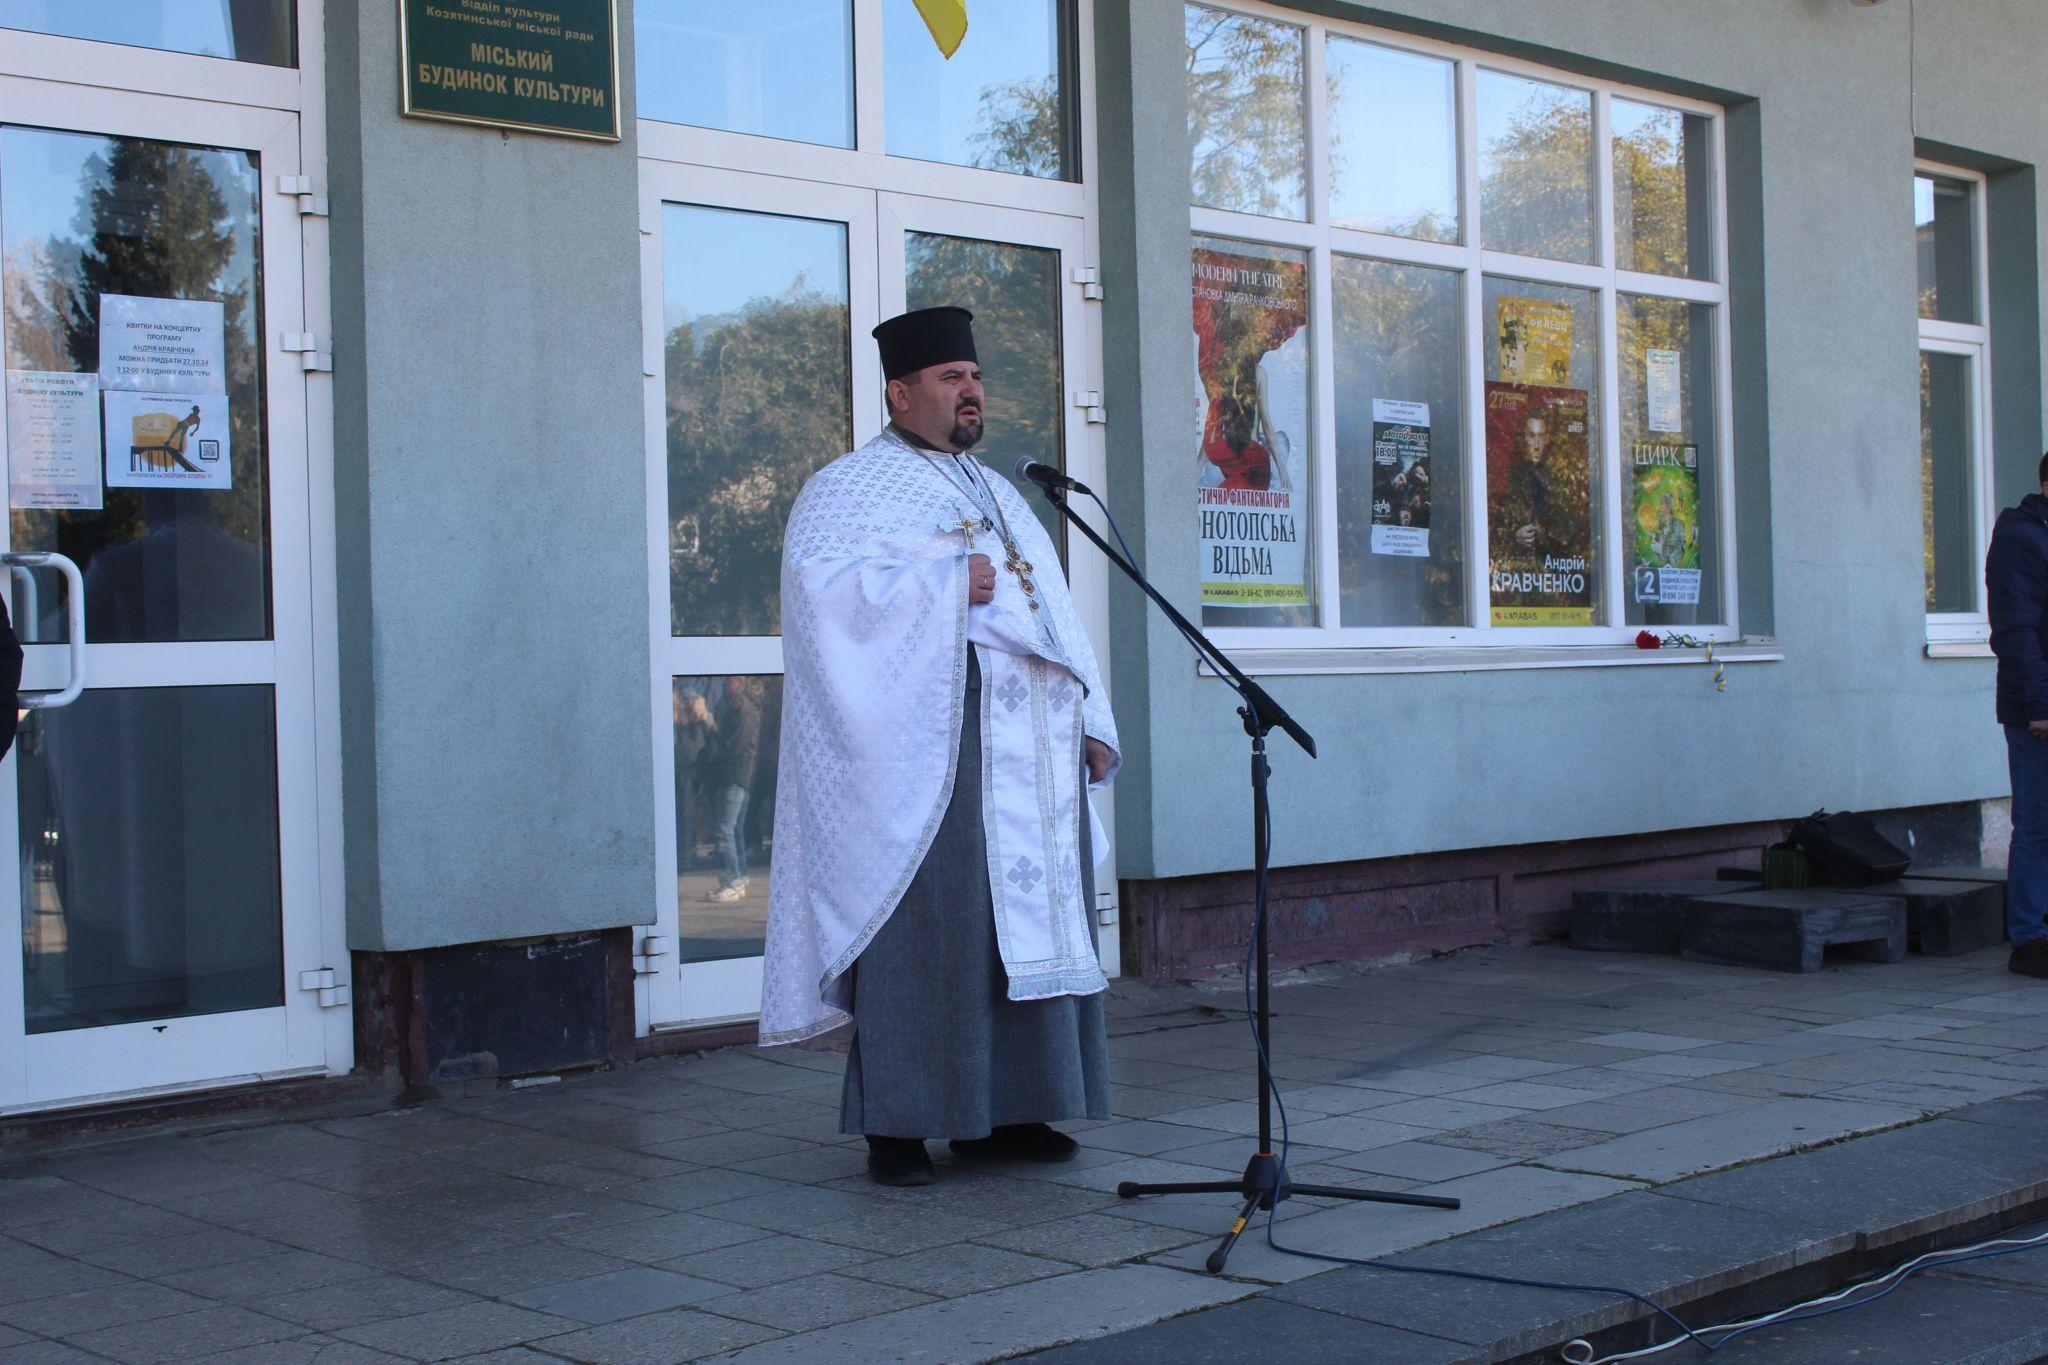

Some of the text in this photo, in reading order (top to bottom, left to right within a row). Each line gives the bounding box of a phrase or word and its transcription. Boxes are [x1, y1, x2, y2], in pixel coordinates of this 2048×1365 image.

[461, 0, 560, 23] Відділ культури
[426, 6, 594, 42] Козятинської міської ради
[471, 42, 553, 72] МІСЬКИЙ
[419, 63, 605, 108] БУДИНОК КУЛЬТУРИ
[1192, 262, 1286, 289] MODERN THEATRE
[126, 322, 153, 330] КВИТКИ
[164, 325, 202, 334] КОНЦЕРТНУ
[147, 334, 182, 342] ПРОГРАМУ
[119, 355, 145, 363] МОЖНА
[133, 344, 195, 354] АНДРІЯ КРАВЧЕНКА
[146, 368, 177, 376] БУДИНКУ
[177, 369, 211, 377] КУЛЬТУРИ
[1489, 390, 1504, 409] 27
[1634, 444, 1682, 467] ЦИРК
[1229, 489, 1290, 508] ФАНТАСМАГОРІЯ
[1198, 510, 1296, 542] НОТОПСЬКА
[1212, 545, 1273, 580] ВІДЬМА
[1544, 554, 1585, 573] Андрій
[1491, 572, 1585, 593] КРАВЧЕНКО
[1644, 571, 1655, 593] 2
